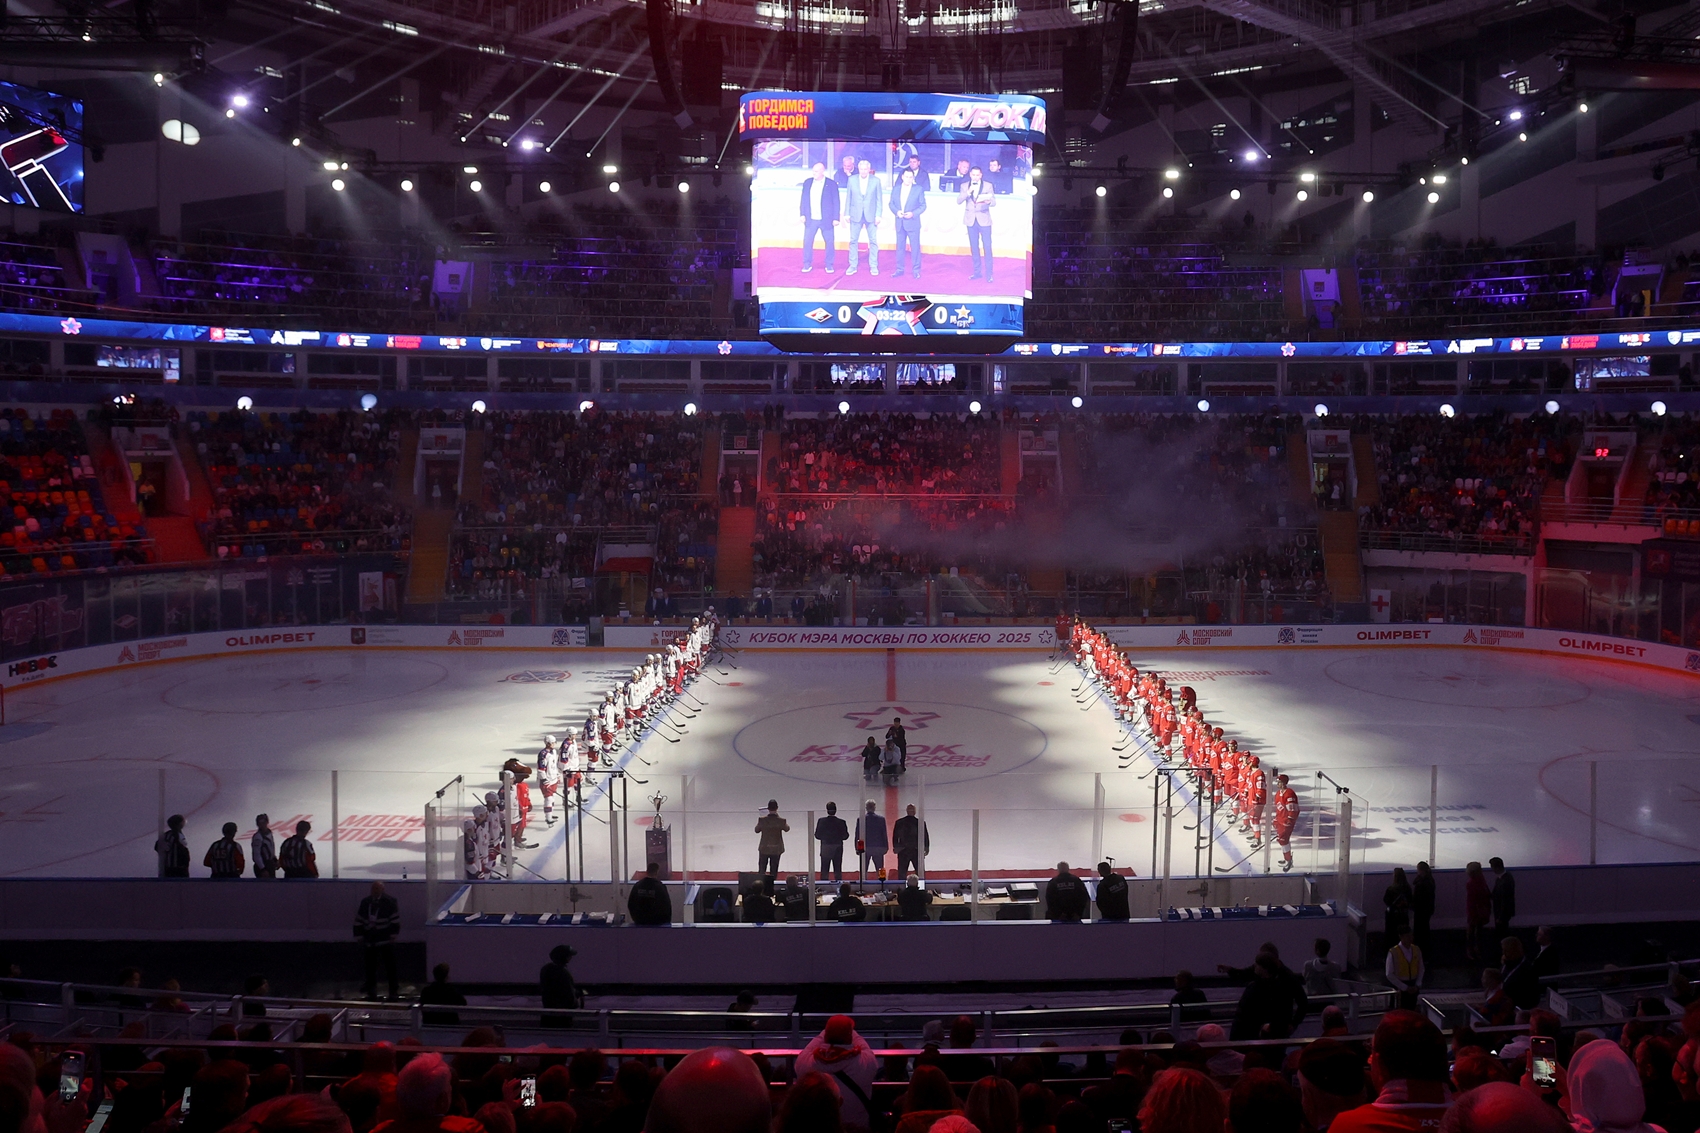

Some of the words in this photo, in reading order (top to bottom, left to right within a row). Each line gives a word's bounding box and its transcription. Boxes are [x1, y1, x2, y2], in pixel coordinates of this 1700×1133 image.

[749, 99, 814, 114] ГОРДИМСЯ
[749, 114, 807, 130] ПОБЕДОЙ!
[941, 102, 1029, 130] КУБОК
[838, 305, 851, 323] 0
[876, 310, 906, 321] 03:22
[935, 306, 948, 324] 0
[463, 628, 504, 638] МОСКОВСКИЙ
[749, 632, 797, 643] КУБОК
[800, 633, 837, 644] МЭРА
[841, 633, 904, 644] МОСКВЫ
[907, 633, 928, 643] ПО
[930, 633, 991, 643] ХОККЕЮ
[997, 633, 1032, 643] 2025
[1192, 628, 1233, 637] МОСКОВСКИЙ
[1356, 630, 1431, 640] OLIMPBET
[1480, 629, 1525, 639] МОСКОВСКИЙ
[138, 637, 188, 650] МОСКОВСКИЙ
[225, 632, 315, 647] OLIMPBET
[463, 638, 482, 646] СПОРТ
[1192, 637, 1211, 645] СПОРТ
[1480, 637, 1501, 645] СПОРТ
[1559, 638, 1647, 657] OLIMPBET
[798, 744, 964, 756] КУОК
[317, 828, 422, 842] СПОРТ
